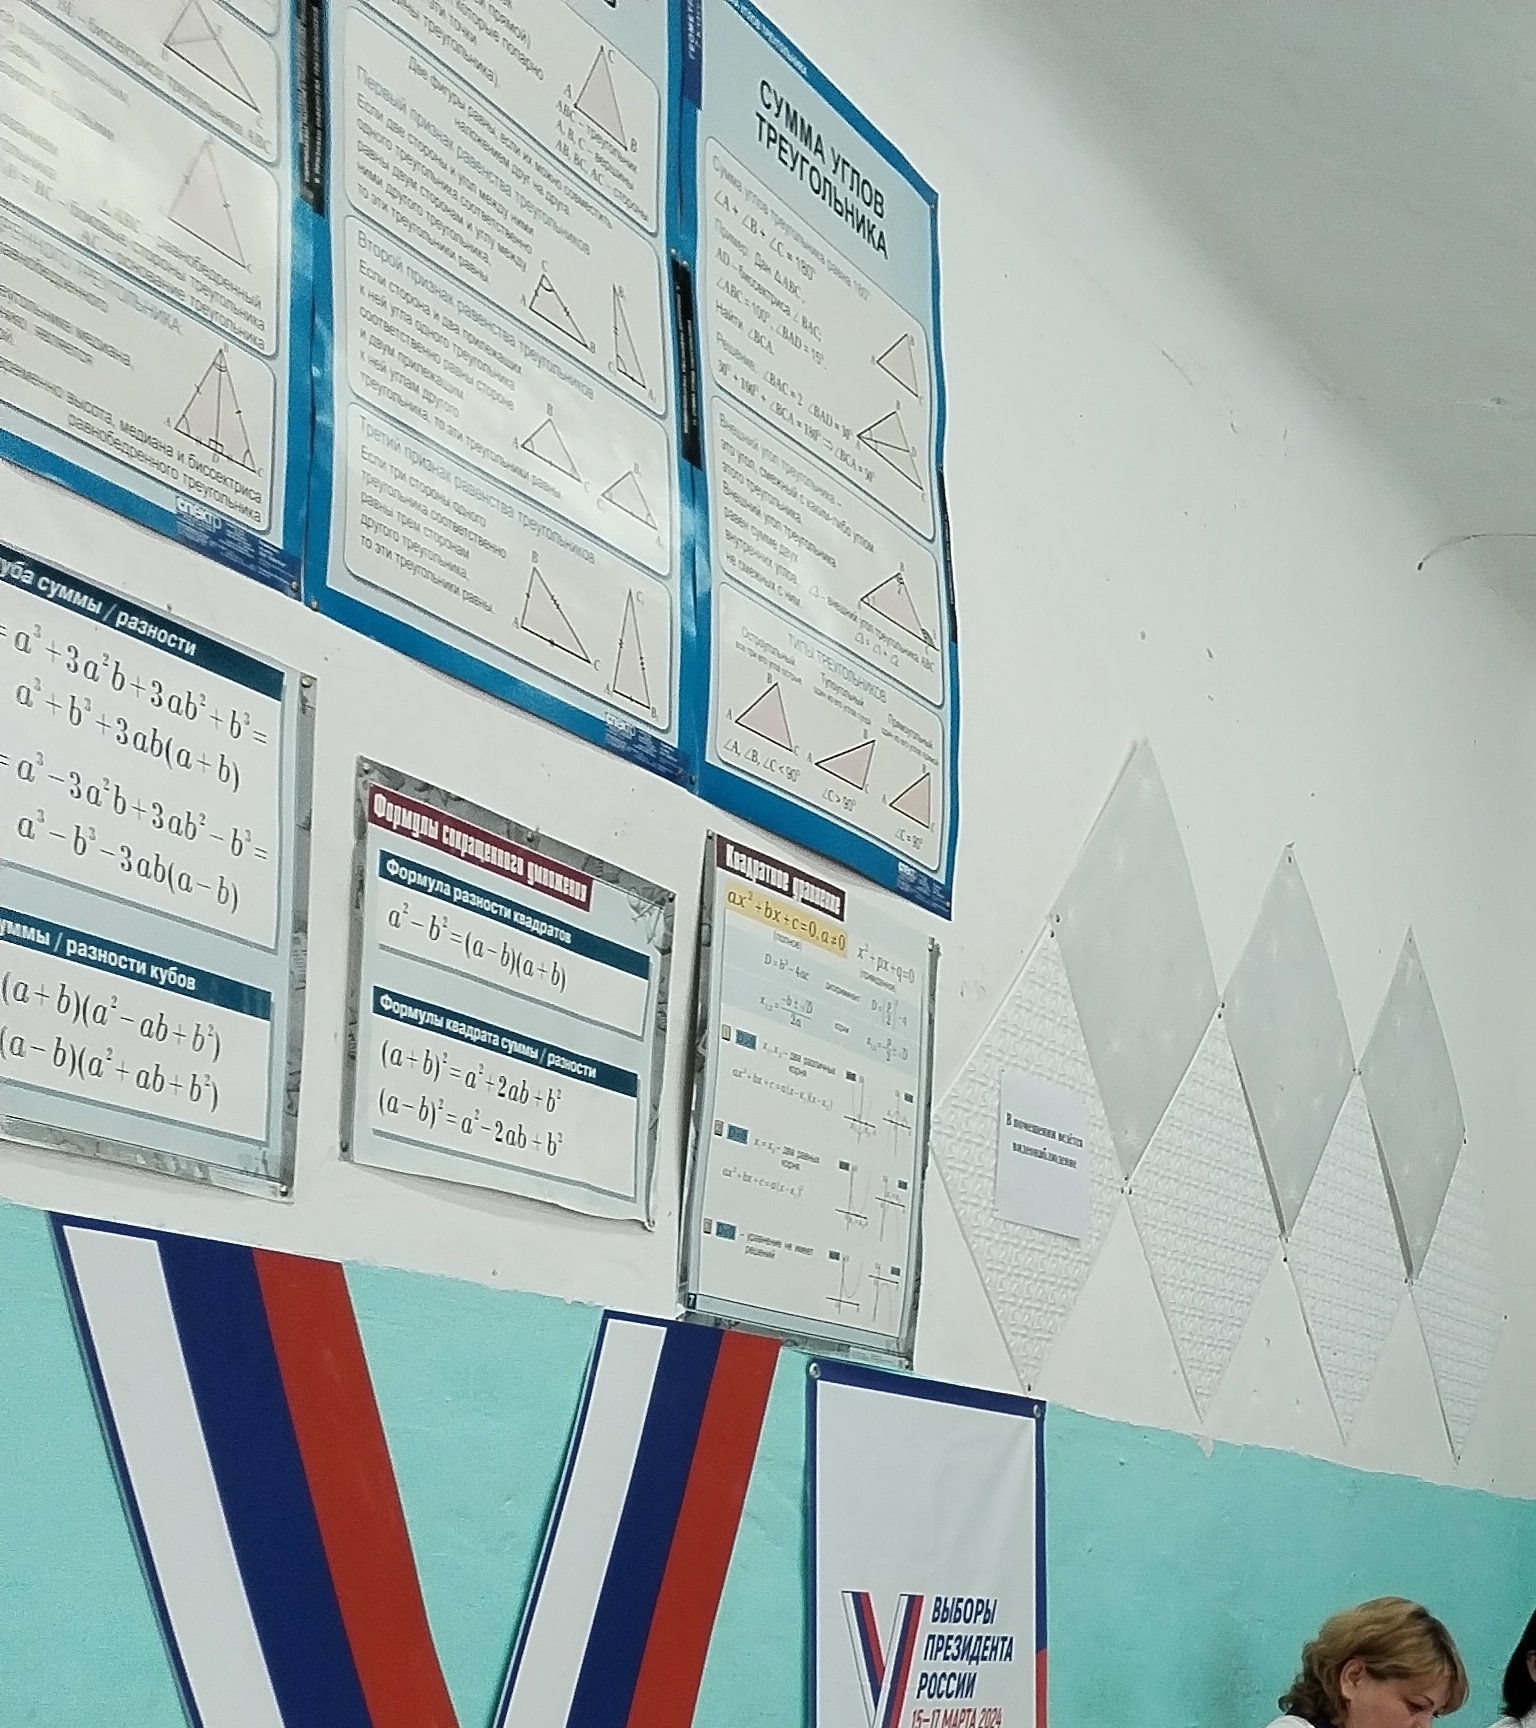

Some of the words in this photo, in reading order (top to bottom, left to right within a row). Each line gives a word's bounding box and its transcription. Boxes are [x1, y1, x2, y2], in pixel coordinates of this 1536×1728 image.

[755, 110, 889, 260] ТРЕУГОЛЬНИКА
[760, 79, 825, 164] СУММА
[830, 146, 885, 218] УГЛОВ
[37, 573, 102, 614] суммы
[116, 611, 197, 656] разности
[374, 792, 438, 839] Формулы
[442, 822, 524, 876] сокращенного
[527, 860, 589, 904] умножения
[386, 858, 451, 896] Формула
[453, 884, 513, 920] разности
[513, 906, 572, 944] квадратов
[66, 938, 147, 975] разности
[150, 965, 196, 992] кубов
[380, 993, 444, 1029] Формулы
[445, 1017, 500, 1046] квадрата
[500, 1034, 539, 1061] суммы
[547, 1051, 597, 1079] разности
[1006, 1112, 1012, 1125] В
[923, 1634, 1014, 1665] ПРЕЗИДЕНТА
[931, 1596, 998, 1625] ВЫБОРЫ
[916, 1672, 977, 1699] РОССИИ
